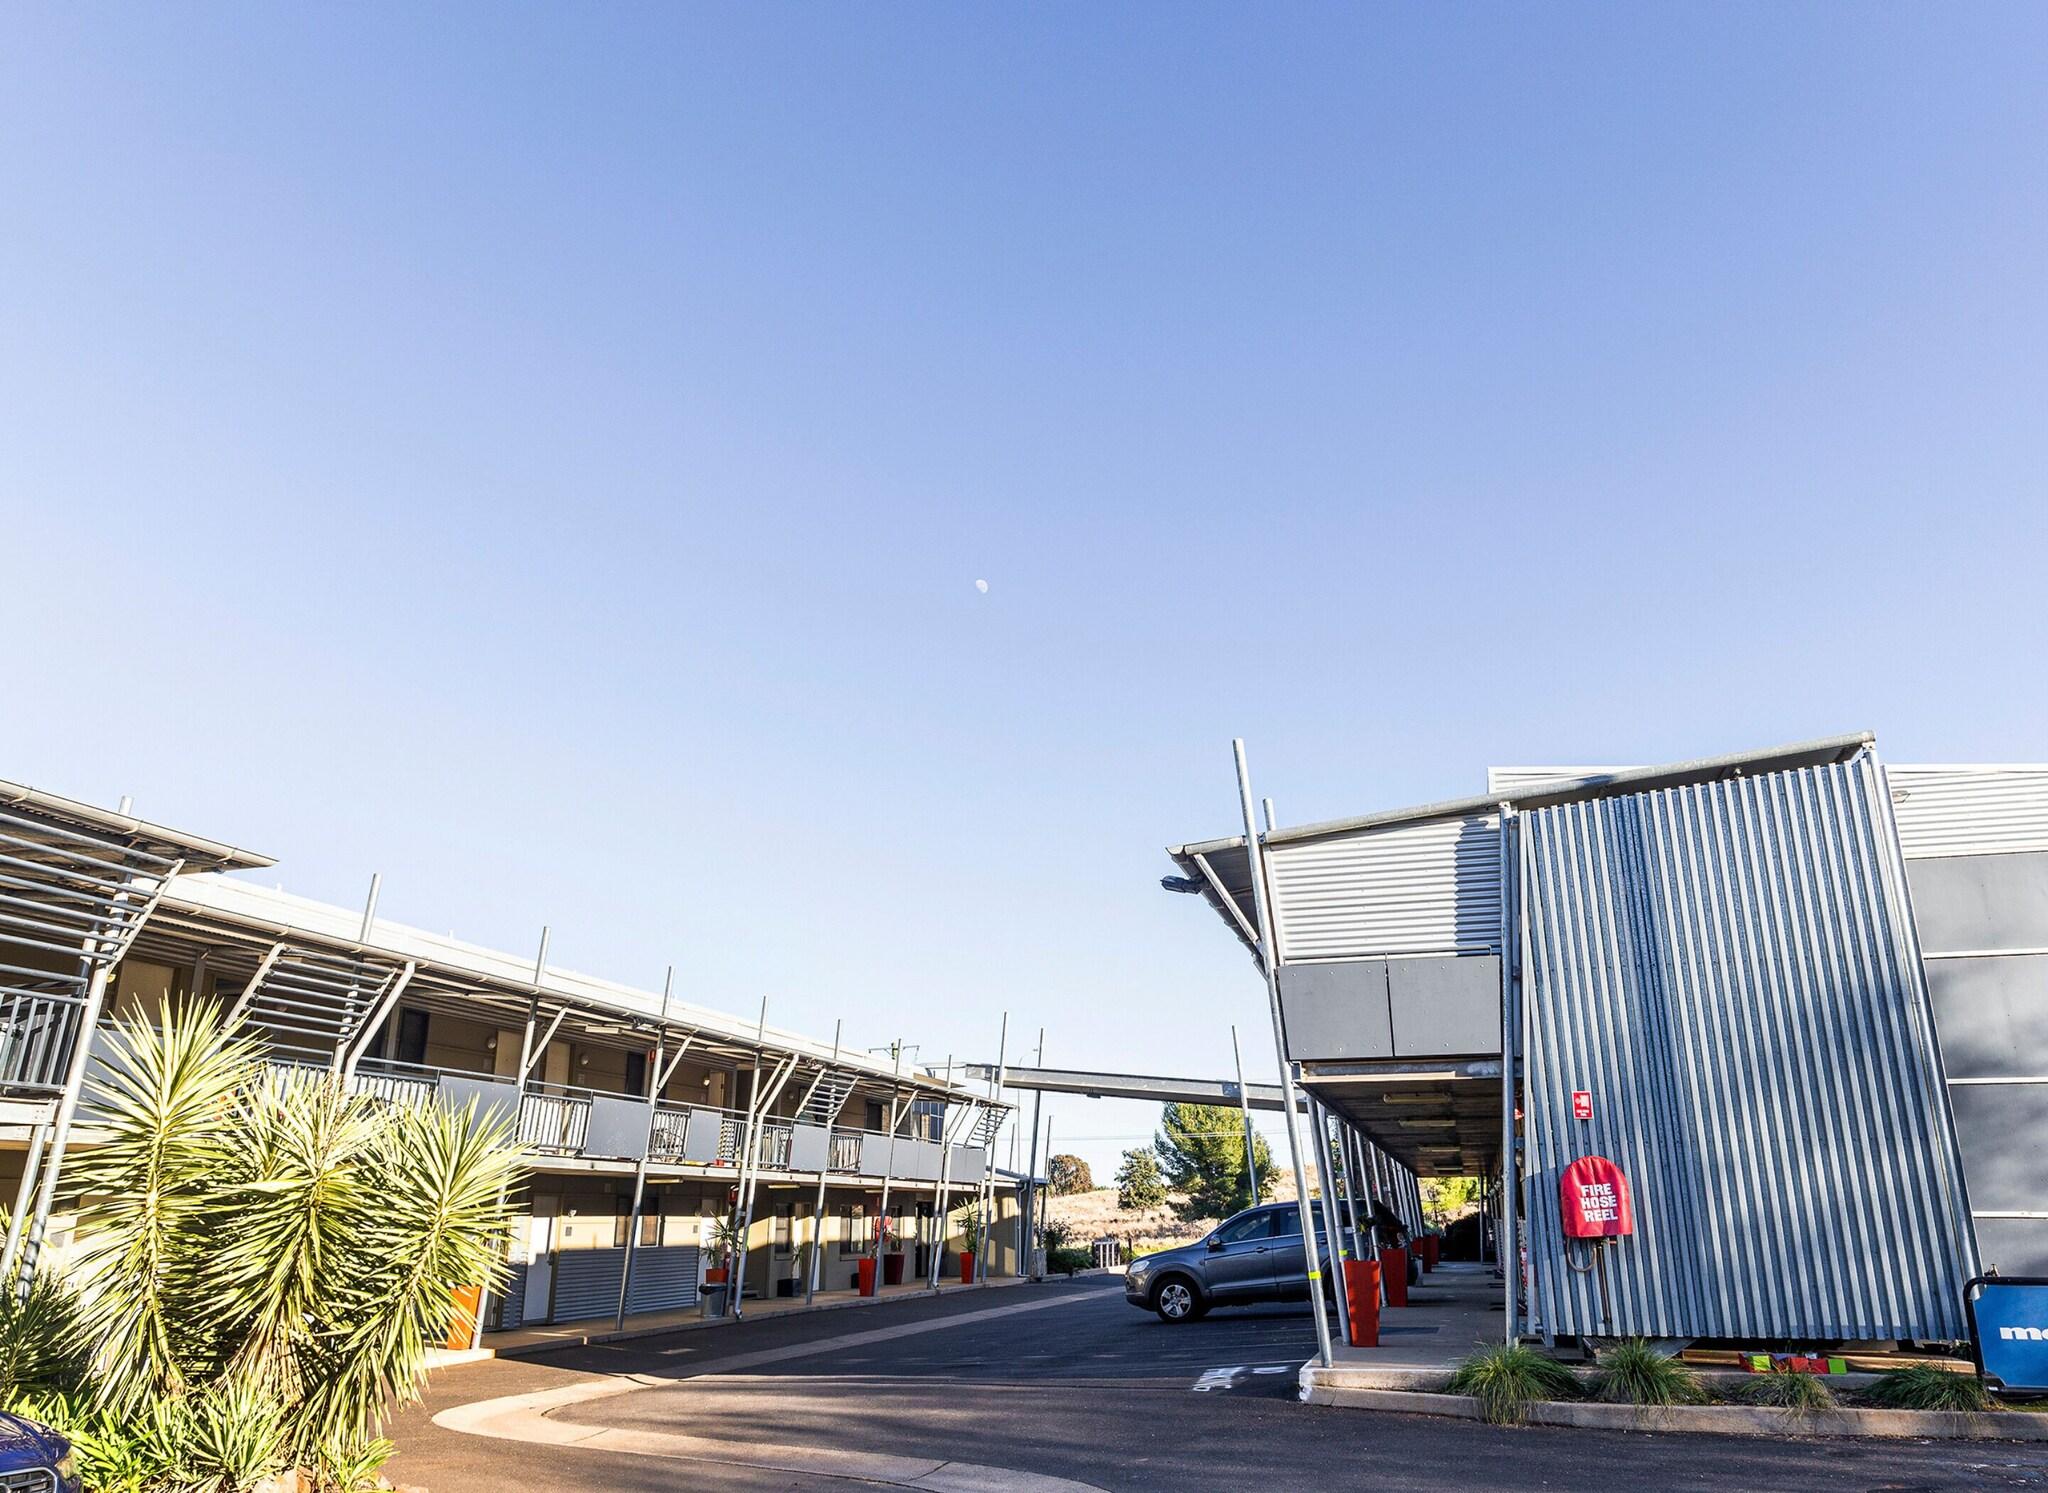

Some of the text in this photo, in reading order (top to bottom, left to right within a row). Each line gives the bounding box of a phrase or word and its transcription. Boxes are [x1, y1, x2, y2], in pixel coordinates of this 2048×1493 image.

[1581, 1183, 1612, 1197] FIRE
[1581, 1195, 1617, 1209] HOSE
[1584, 1208, 1618, 1222] REEL
